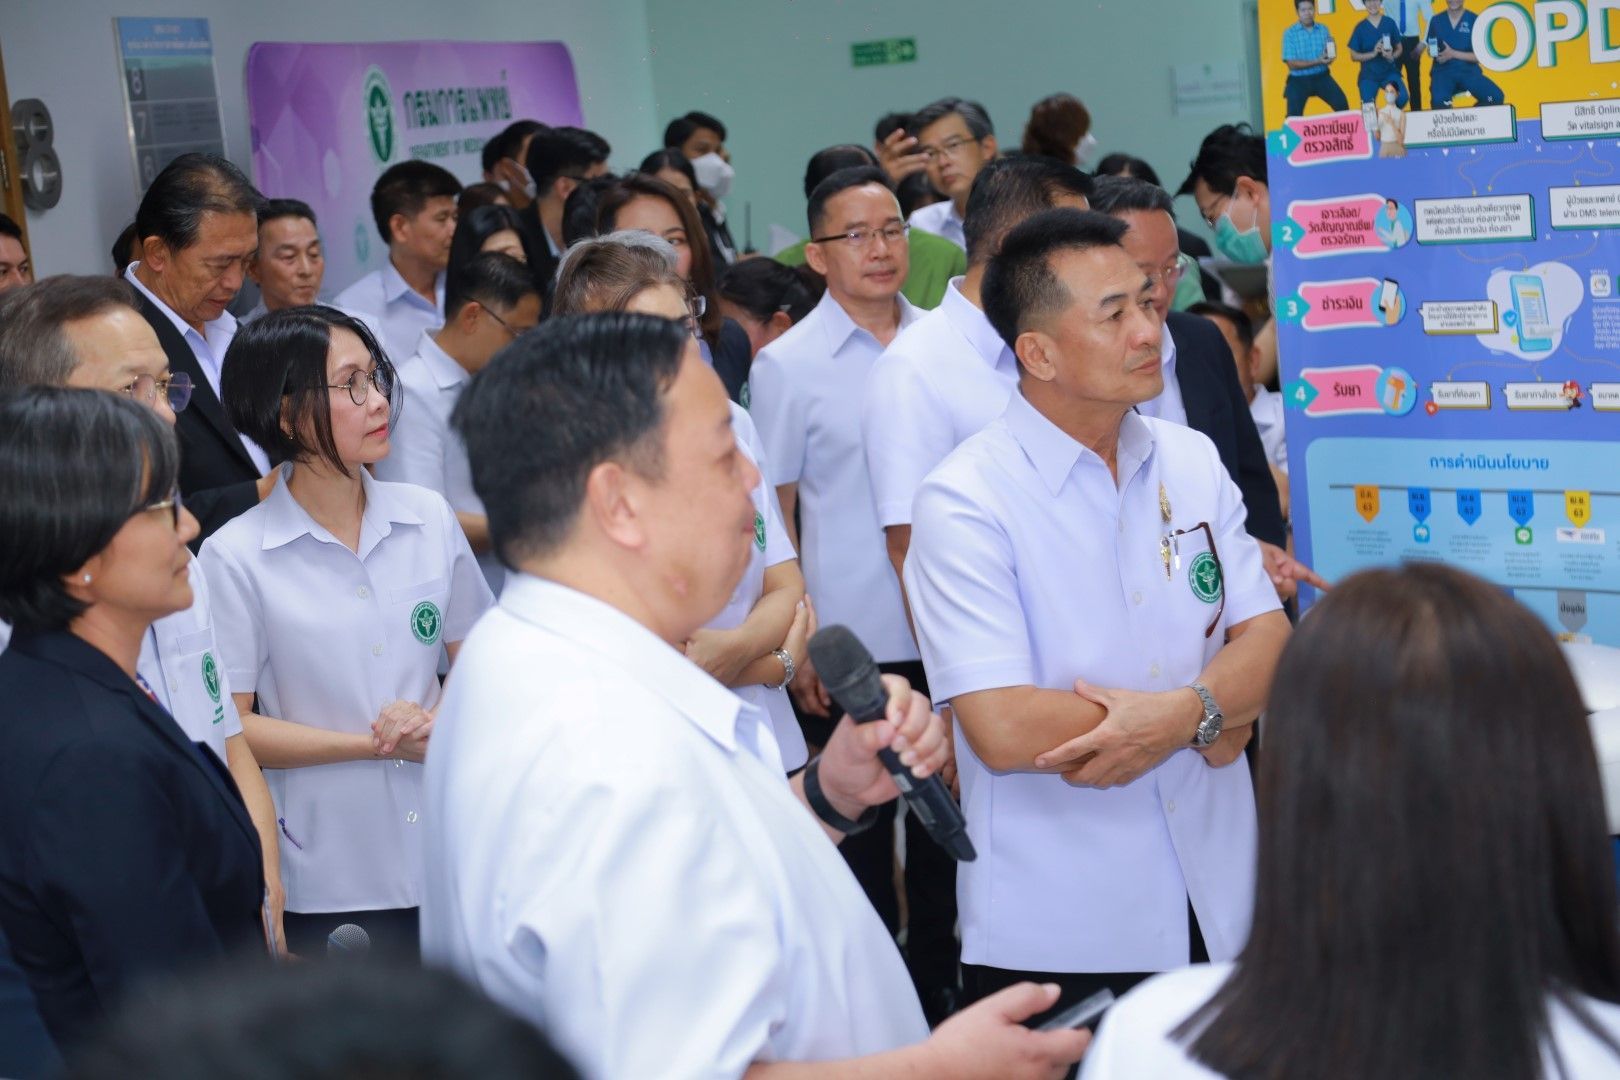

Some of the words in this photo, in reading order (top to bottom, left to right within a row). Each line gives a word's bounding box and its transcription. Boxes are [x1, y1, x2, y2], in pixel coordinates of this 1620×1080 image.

[1471, 0, 1620, 72] OPD
[403, 69, 512, 131] กรมการแพทย์
[1303, 119, 1359, 137] ลงทะเบียน/
[1279, 133, 1288, 150] 1
[1321, 206, 1361, 220] เจาะเลือด/
[1282, 225, 1293, 242] 2
[1308, 219, 1375, 234] วัดสัญญาณชีพ/
[1321, 233, 1365, 246] ตรวจรักษา
[1287, 300, 1298, 317] 3
[1322, 295, 1363, 311] ชำระเงิน
[1295, 385, 1306, 402] 4
[1333, 381, 1362, 398] รับยา
[1430, 452, 1550, 470] การดำเนินนโยบาย
